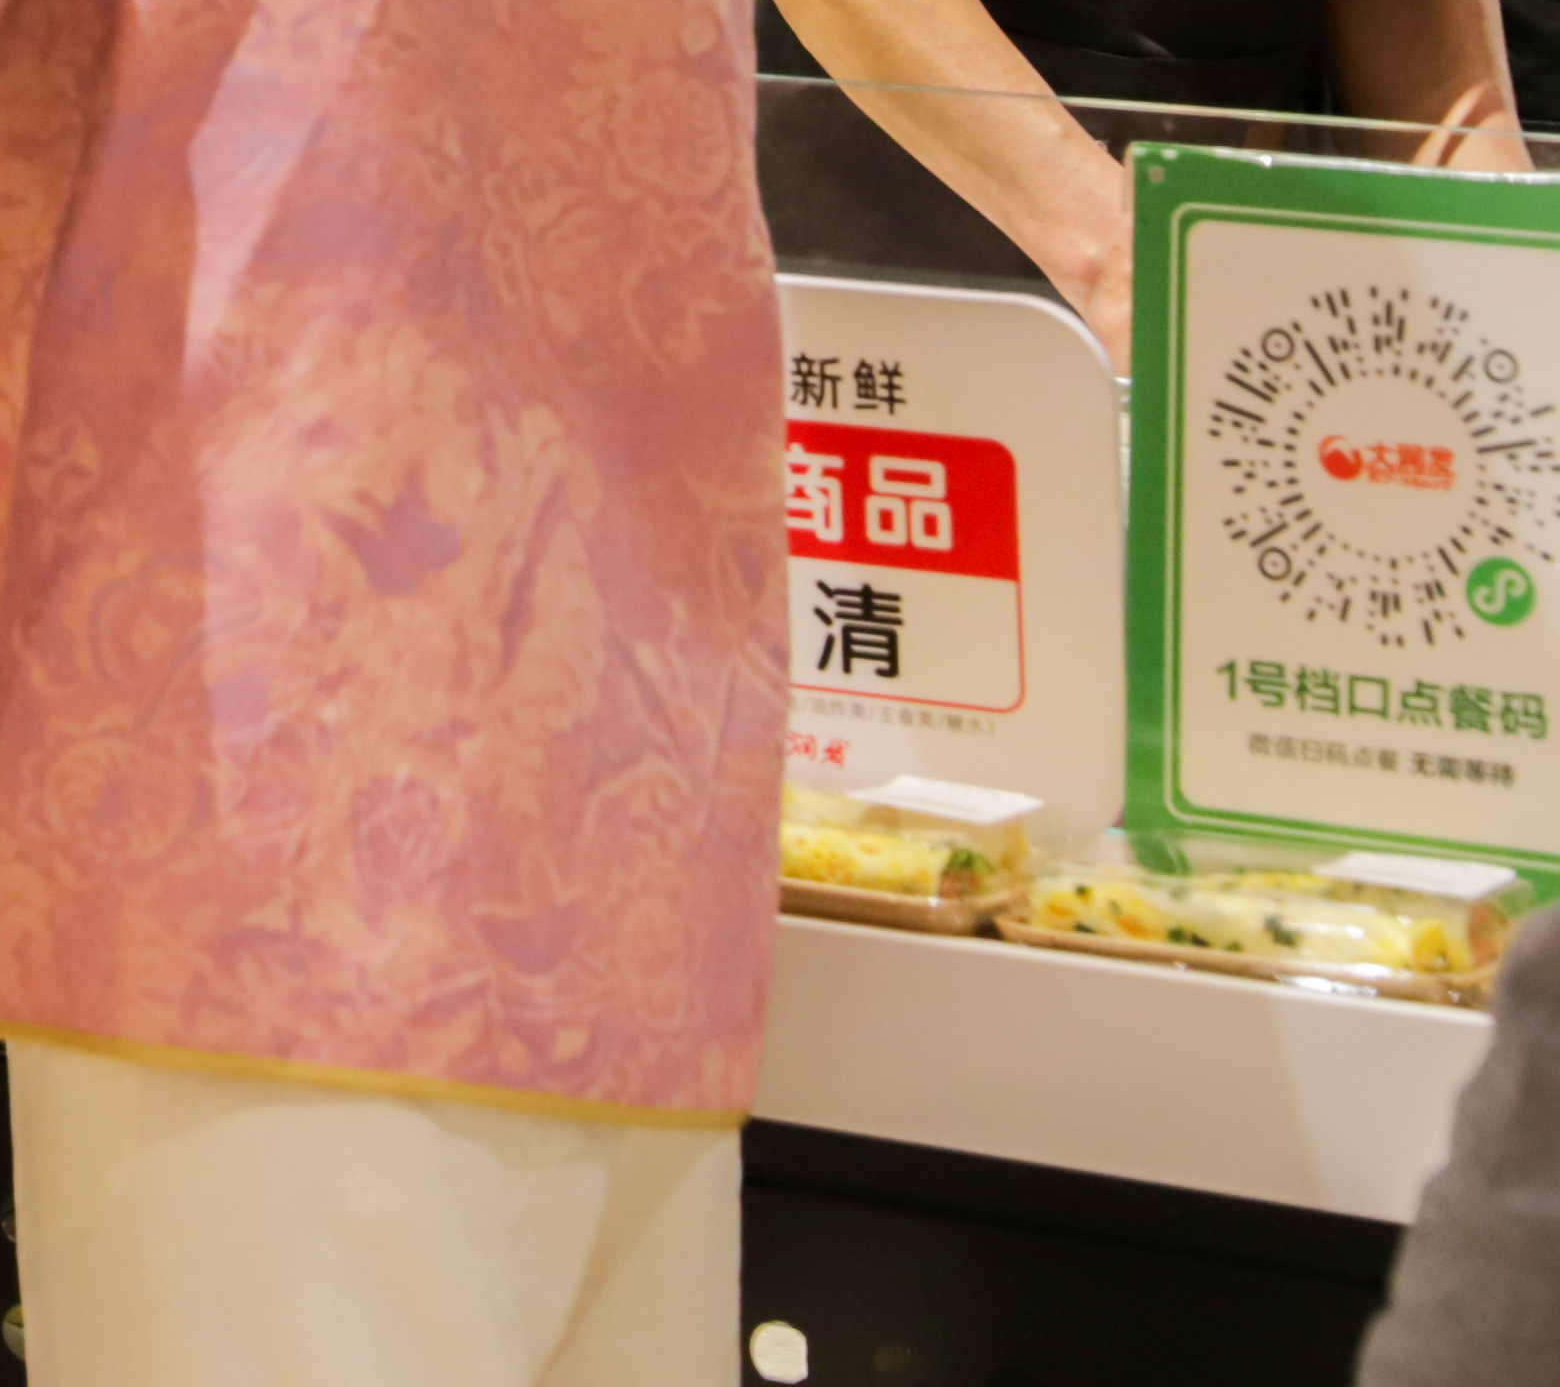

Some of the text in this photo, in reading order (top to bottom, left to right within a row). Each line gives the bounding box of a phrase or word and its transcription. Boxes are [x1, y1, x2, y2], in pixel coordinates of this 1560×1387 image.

[790, 352, 907, 417] 新鲜
[813, 580, 905, 679] 清
[1215, 658, 1550, 741] 1号档口点餐码
